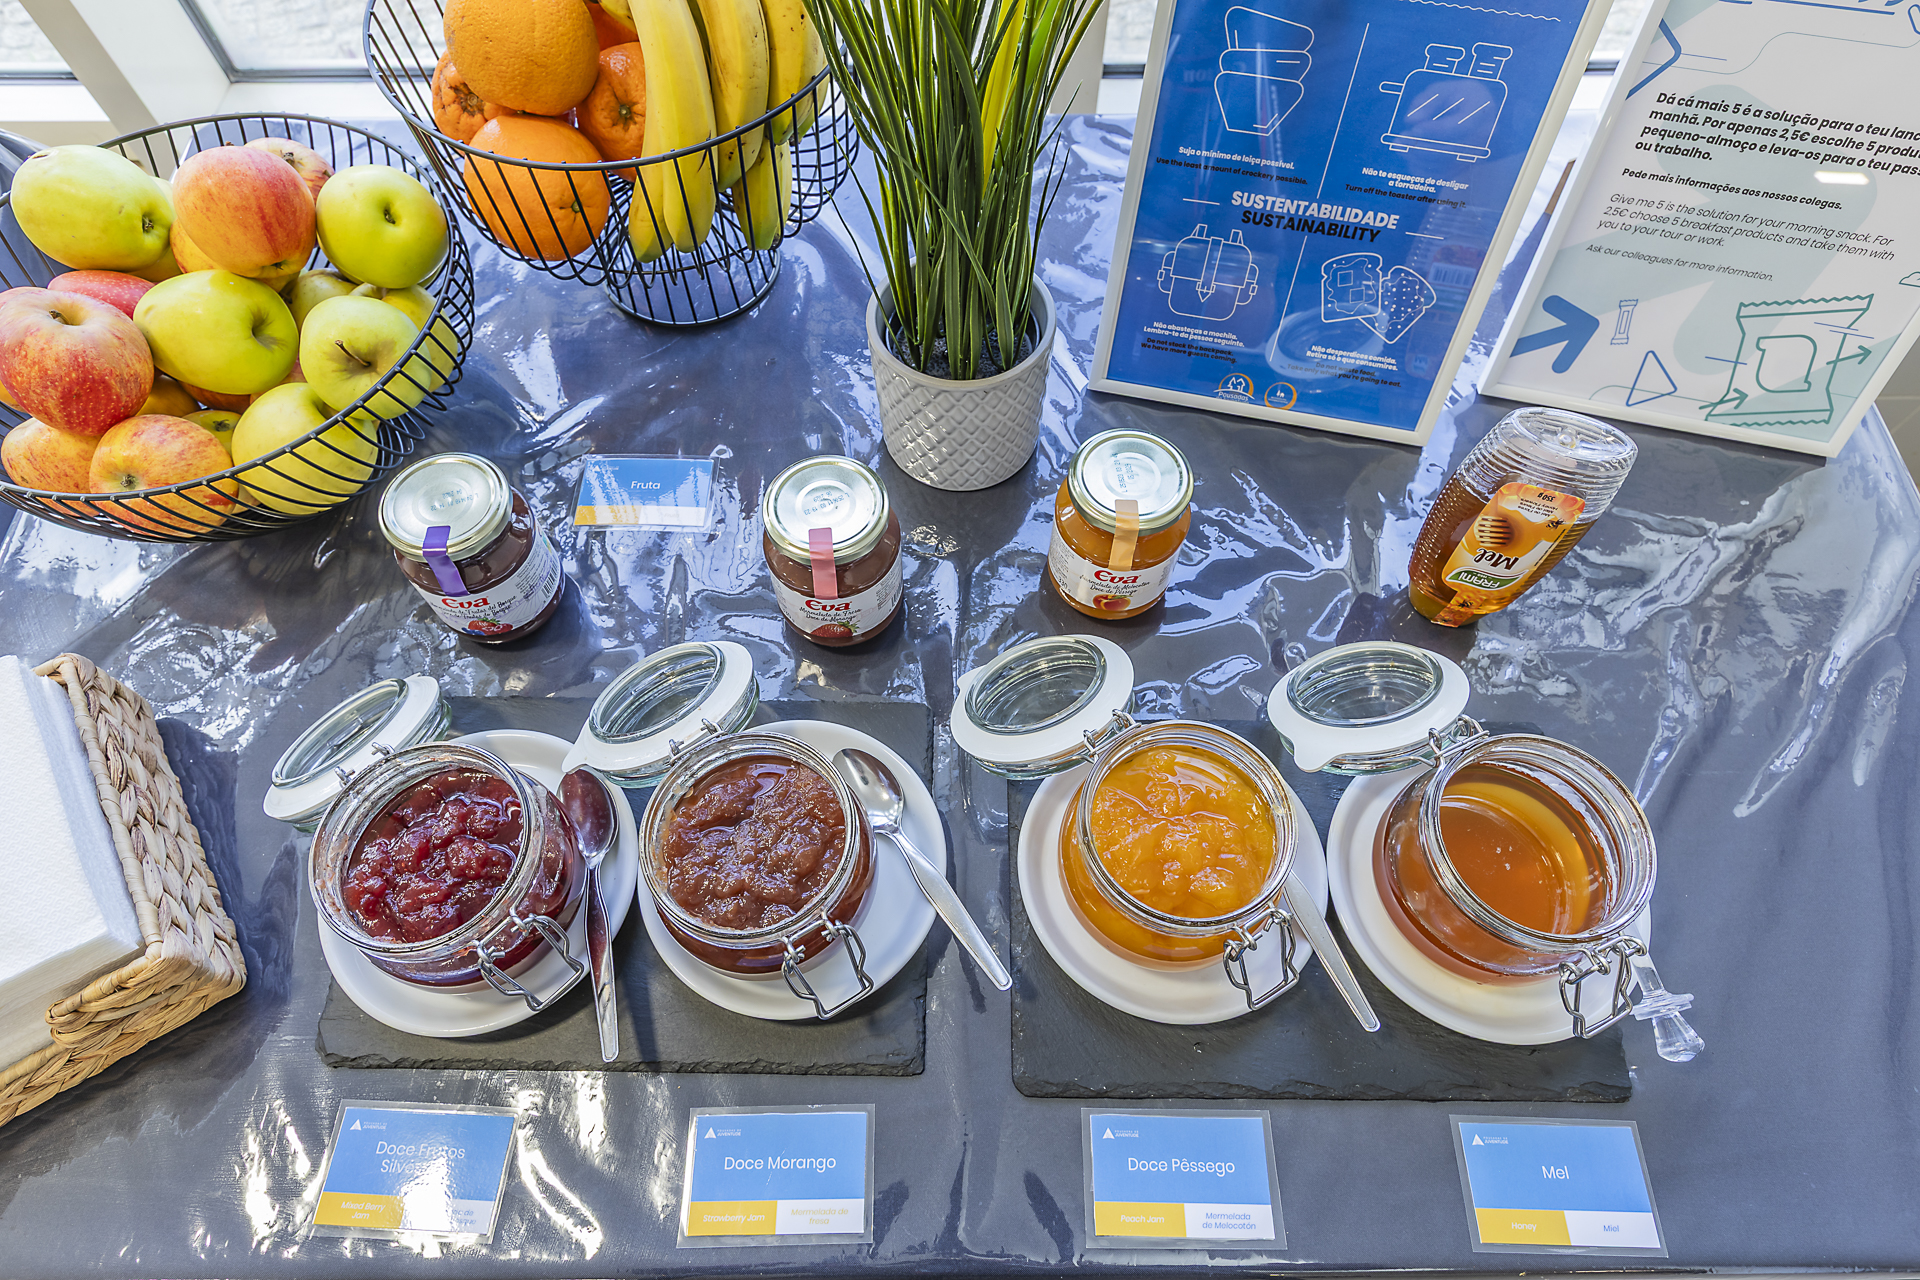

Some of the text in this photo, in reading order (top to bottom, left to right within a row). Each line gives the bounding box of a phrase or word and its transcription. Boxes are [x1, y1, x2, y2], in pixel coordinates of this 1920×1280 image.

[1656, 92, 1676, 104] Dá
[1677, 95, 1695, 107] cá
[1695, 100, 1730, 112] mais
[1732, 103, 1742, 114] 5
[1742, 104, 1752, 115] é
[1753, 109, 1763, 118] a
[1764, 110, 1818, 127] solução
[1817, 119, 1854, 131] para
[1855, 124, 1864, 132] o
[1866, 124, 1890, 136] teu
[1649, 110, 1699, 125] manhã.
[1702, 116, 1726, 128] Por
[1727, 122, 1778, 137] apenas
[1779, 128, 1810, 141] 2,5€
[1811, 135, 1864, 149] escolhe
[1866, 140, 1877, 151] 5
[1635, 142, 1712, 160] ou trabalho.
[1640, 126, 1757, 152] pequeno-almoço
[1759, 144, 1767, 152] e
[1768, 143, 1821, 160] leva-os
[1819, 153, 1856, 165] para
[1867, 158, 1892, 170] teu
[1179, 146, 1195, 156] Suja
[1201, 150, 1231, 159] mínimo
[1242, 155, 1261, 165] loiça
[1261, 159, 1294, 169] possível.
[1156, 157, 1169, 165] Use
[1184, 160, 1201, 169] least
[1203, 164, 1232, 173] amount
[1241, 170, 1273, 181] crockery
[1276, 175, 1308, 184] possible.
[1362, 167, 1378, 175] Não
[1387, 172, 1424, 184] esqueças
[1436, 179, 1469, 190] desligar
[1346, 184, 1362, 192] Turn
[1389, 191, 1416, 200] toaster
[1417, 195, 1436, 203] after
[1395, 180, 1436, 193] torradeira.
[1622, 168, 1842, 209] Pede mais informações aos nossos colegas.
[1231, 191, 1400, 229] SUSTENTABILIDADE
[1241, 210, 1381, 242] SUSTAINABILITY
[1610, 193, 1894, 246] Give me 5 is the solution for your morning snack. For
[1596, 220, 1619, 229] you
[1620, 222, 1632, 231] to
[1631, 225, 1659, 235] your
[1659, 229, 1684, 239] tour
[1697, 236, 1725, 246] work.
[1603, 206, 1895, 260] 2,5€ choose 5 breakfast products and take them with
[1586, 244, 1603, 253] Ask
[1621, 251, 1674, 264] colleagues
[1674, 258, 1689, 266] for
[1688, 262, 1715, 271] more
[1715, 264, 1773, 281] information.
[1144, 326, 1179, 336] Lembra-te
[1189, 332, 1213, 341] pessoa
[1214, 338, 1244, 347] seguinte.
[1167, 324, 1202, 334] abasteças
[1209, 331, 1237, 339] mochila.
[631, 481, 661, 490] Fruta
[1542, 494, 1556, 502] 350
[1473, 548, 1519, 570] Mel
[1094, 569, 1139, 584] Eva
[441, 597, 490, 609] Eva
[805, 599, 851, 612] Eva
[376, 1141, 415, 1155] Doce
[724, 1156, 836, 1173] Doce Morango
[1128, 1157, 1235, 1177] Doce Pêssego
[1541, 1165, 1570, 1180] Mel
[341, 1201, 386, 1213] Mixed Berry
[351, 1211, 369, 1220] Jam
[703, 1214, 765, 1223] Strawberry Jam
[809, 1217, 829, 1225] fresa
[1120, 1214, 1165, 1224] Peach Jam
[1205, 1212, 1251, 1220] Mermelada
[1214, 1221, 1256, 1230] Melocotón
[1511, 1221, 1537, 1232] Honey
[1603, 1224, 1619, 1232] Miel
